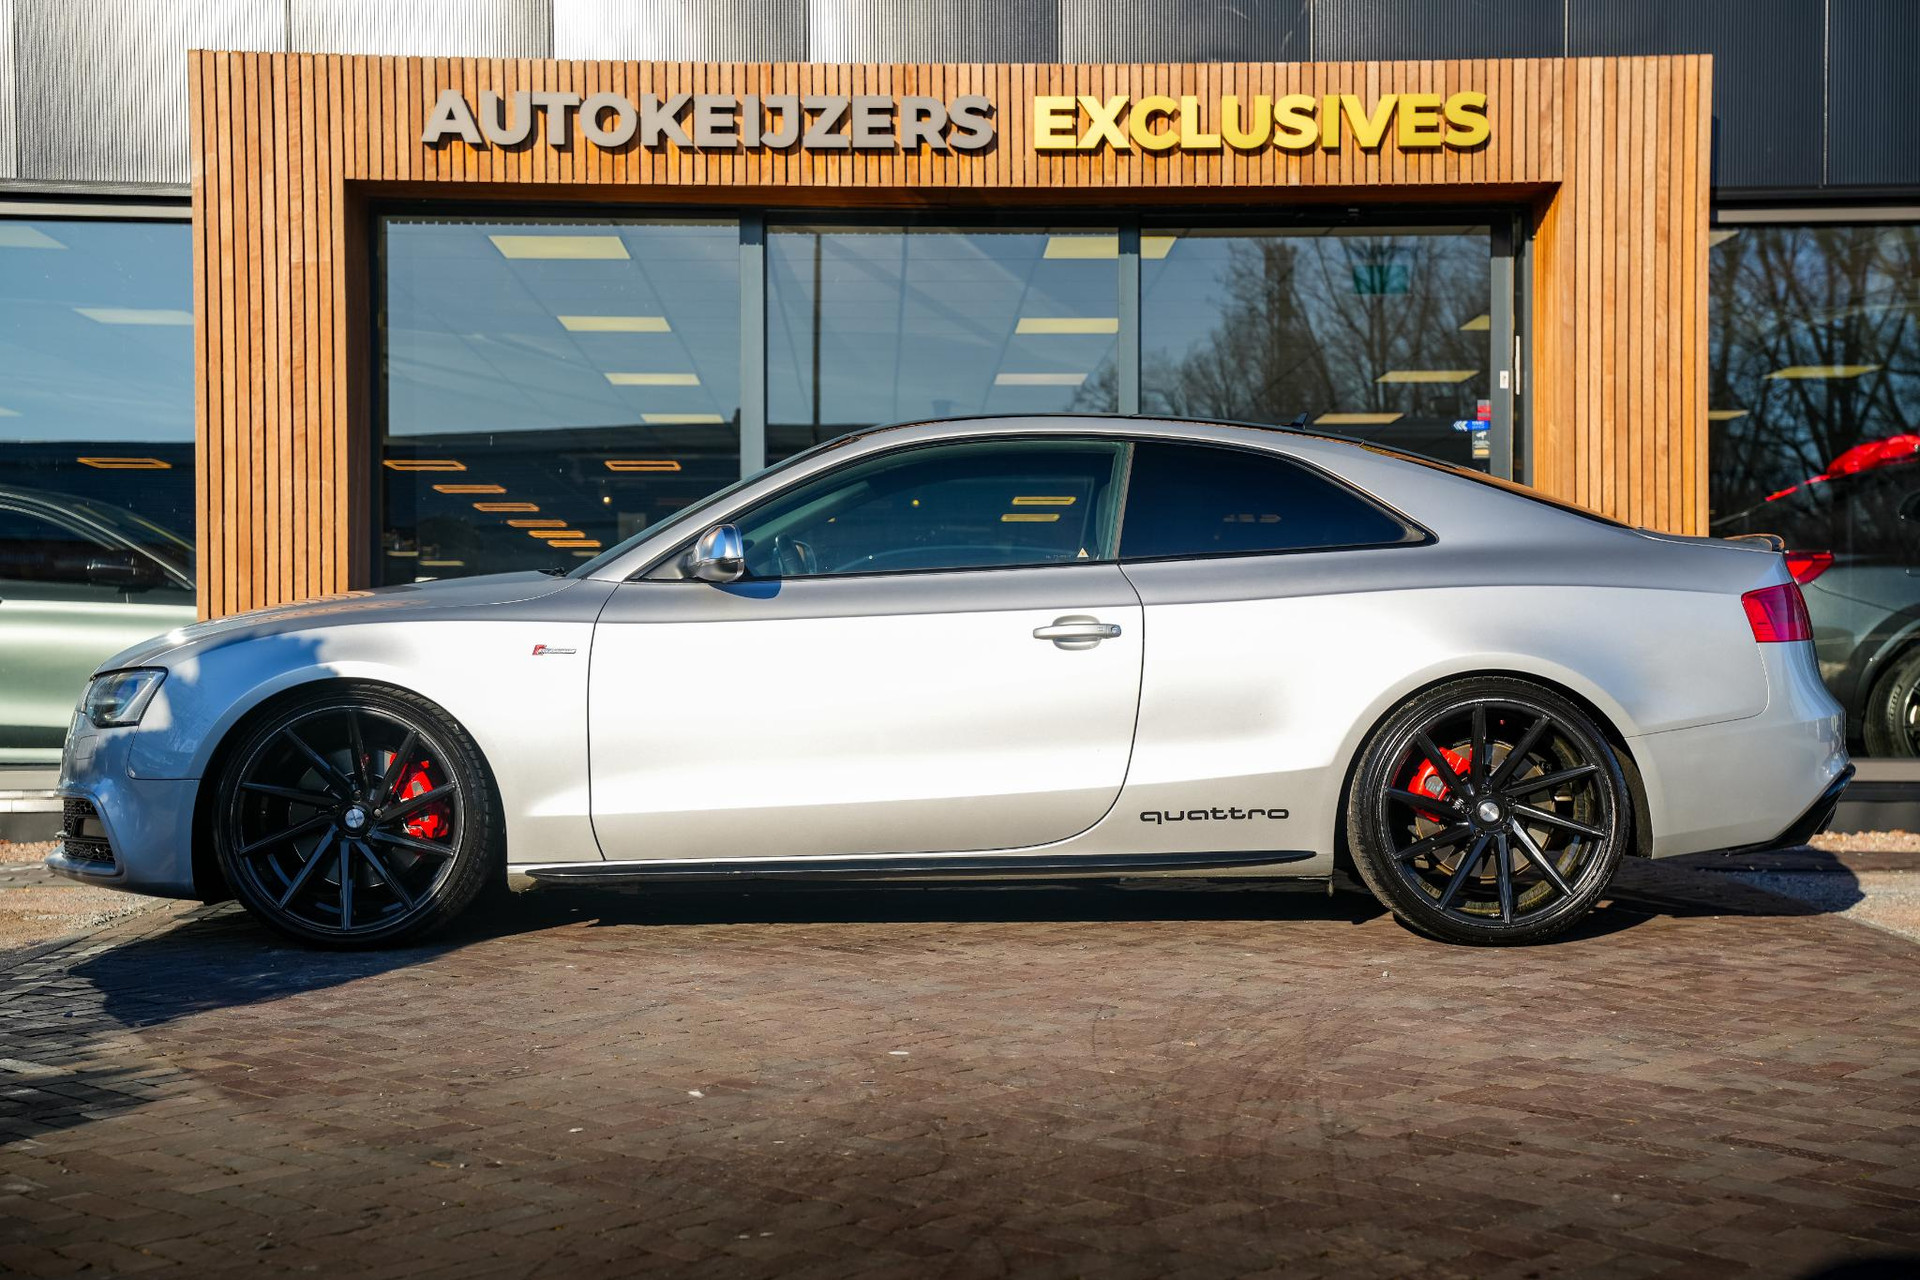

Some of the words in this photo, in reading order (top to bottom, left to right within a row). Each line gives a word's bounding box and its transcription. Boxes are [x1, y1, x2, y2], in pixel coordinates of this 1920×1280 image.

[421, 88, 996, 151] AUTOKEIJZERS
[1033, 91, 1491, 152] EXCLUSIVES
[1139, 807, 1290, 825] quattro
